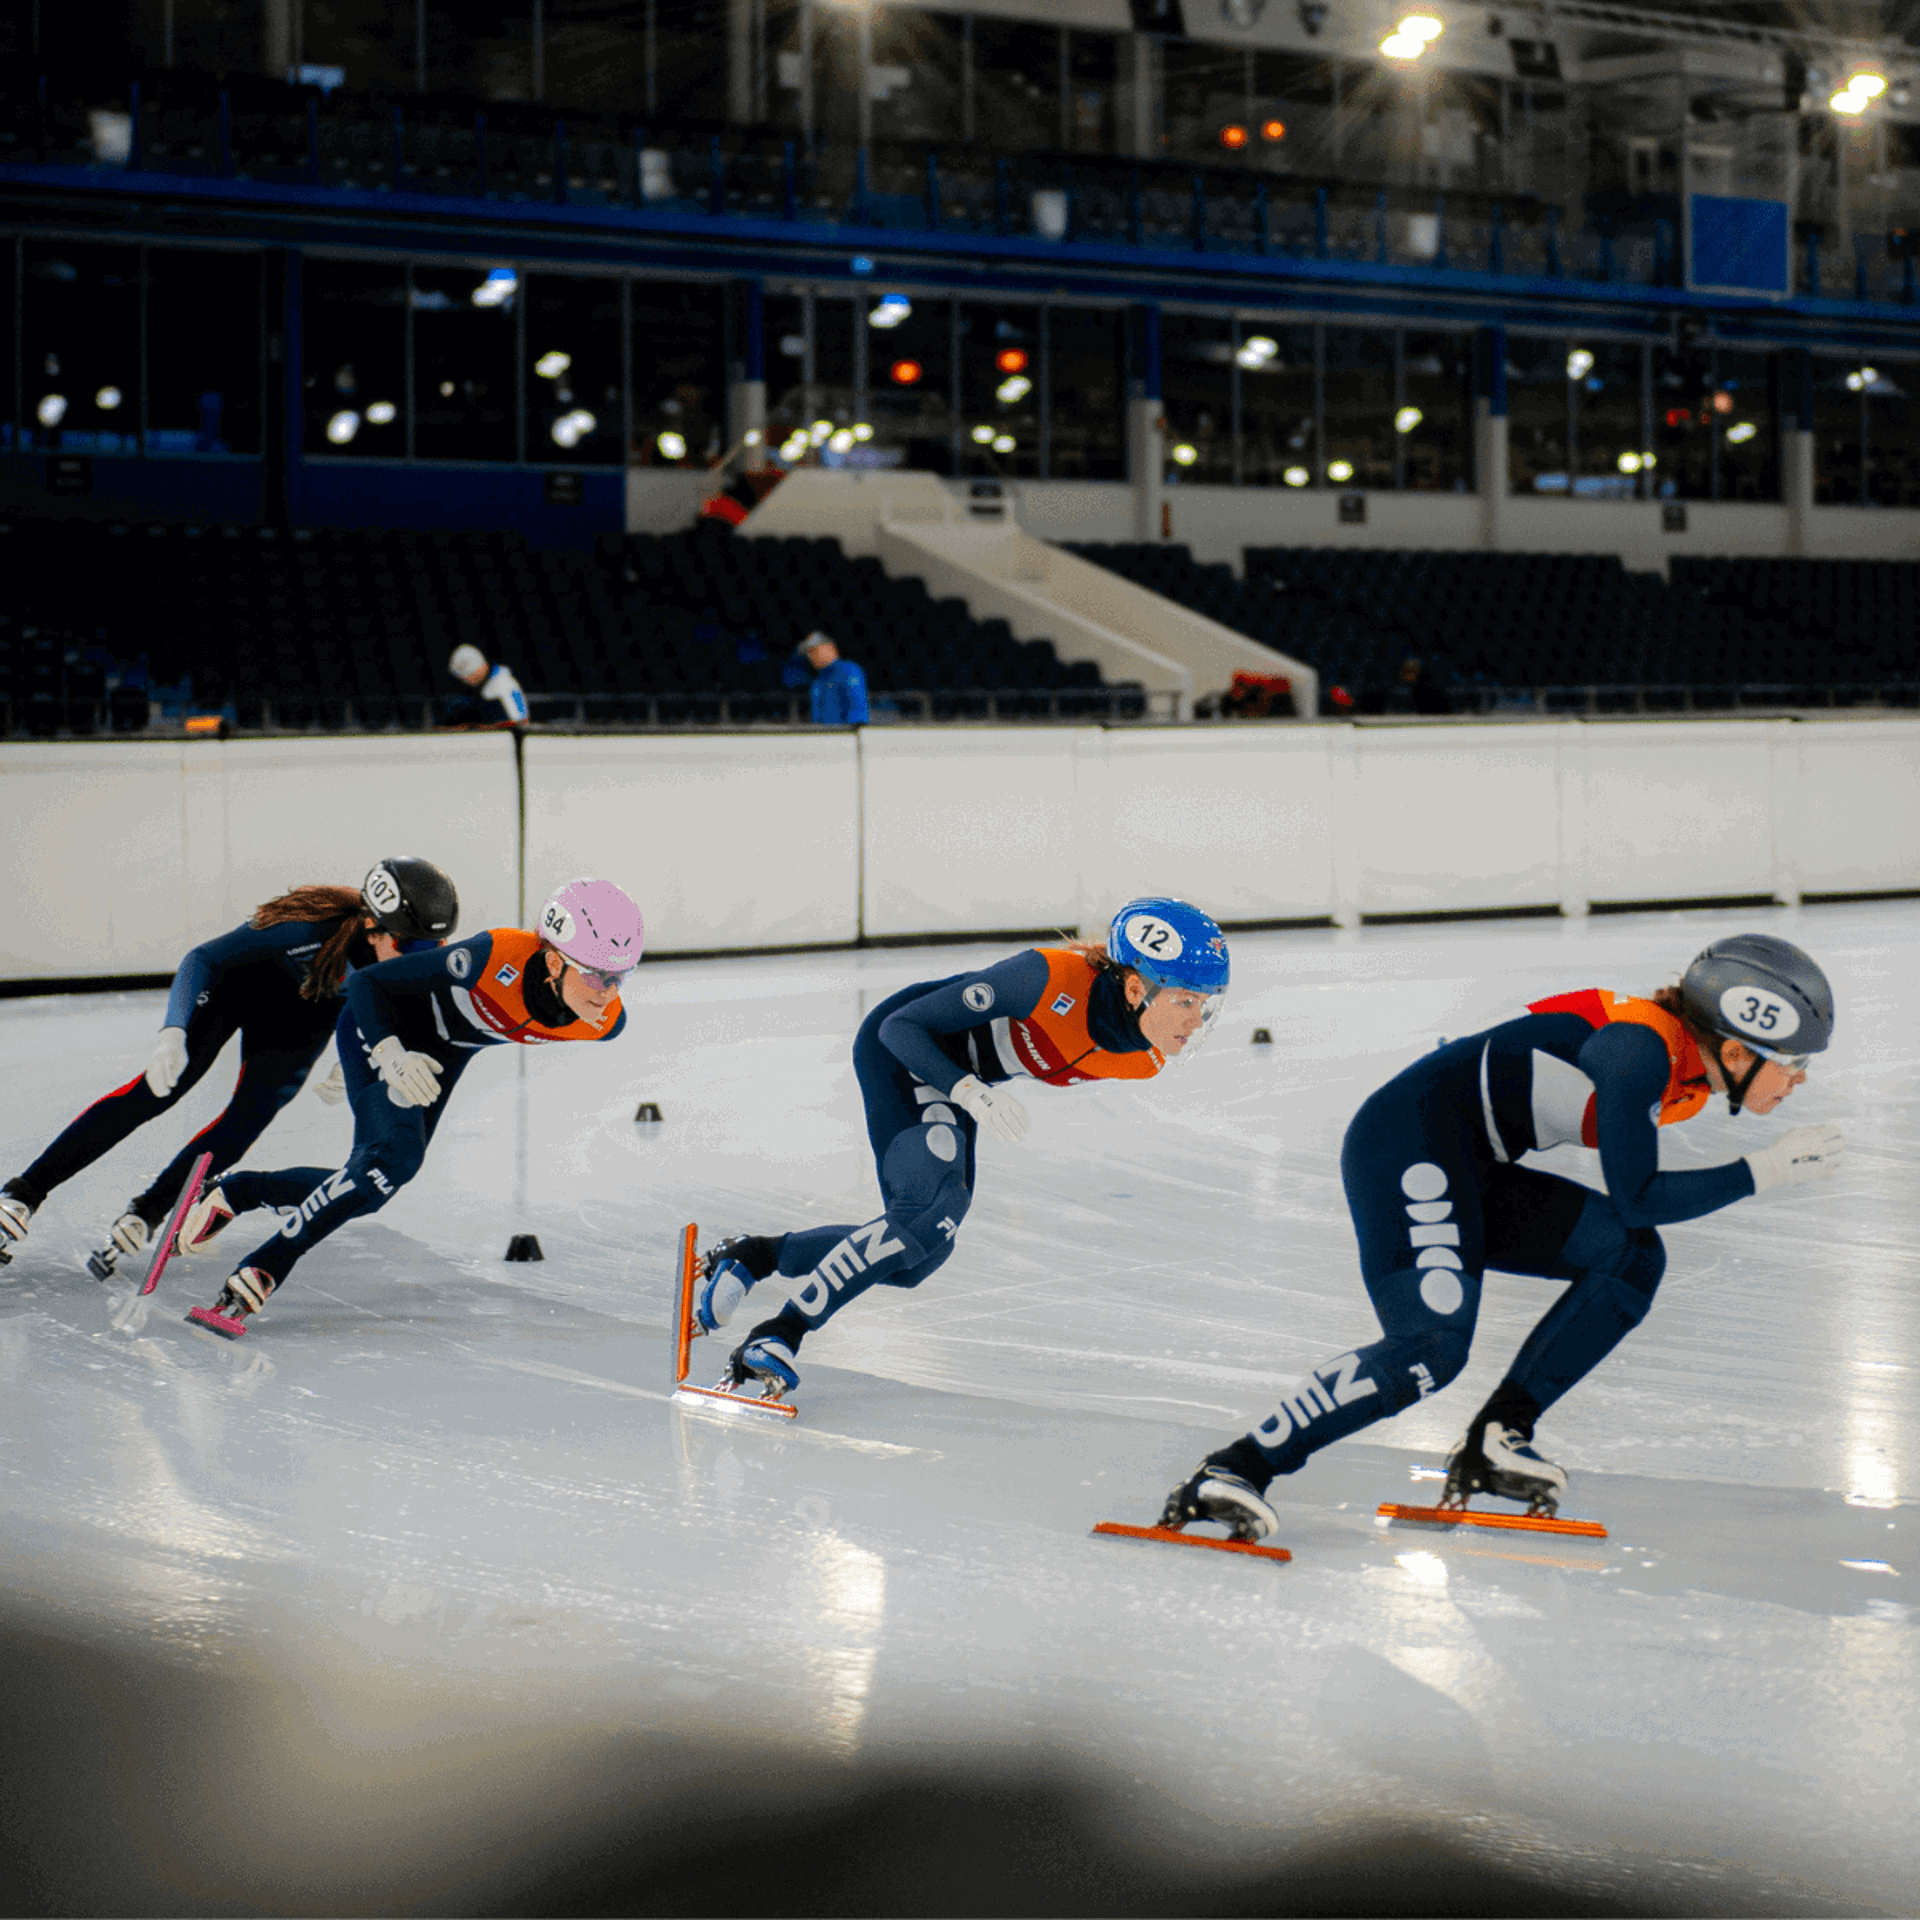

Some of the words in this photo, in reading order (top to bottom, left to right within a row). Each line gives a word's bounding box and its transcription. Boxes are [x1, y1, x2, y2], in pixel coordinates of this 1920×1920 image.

[371, 874, 396, 905] 107
[545, 907, 566, 935] 94
[1140, 923, 1170, 952] 12
[1739, 996, 1780, 1030] 35
[789, 1218, 907, 1317] NED
